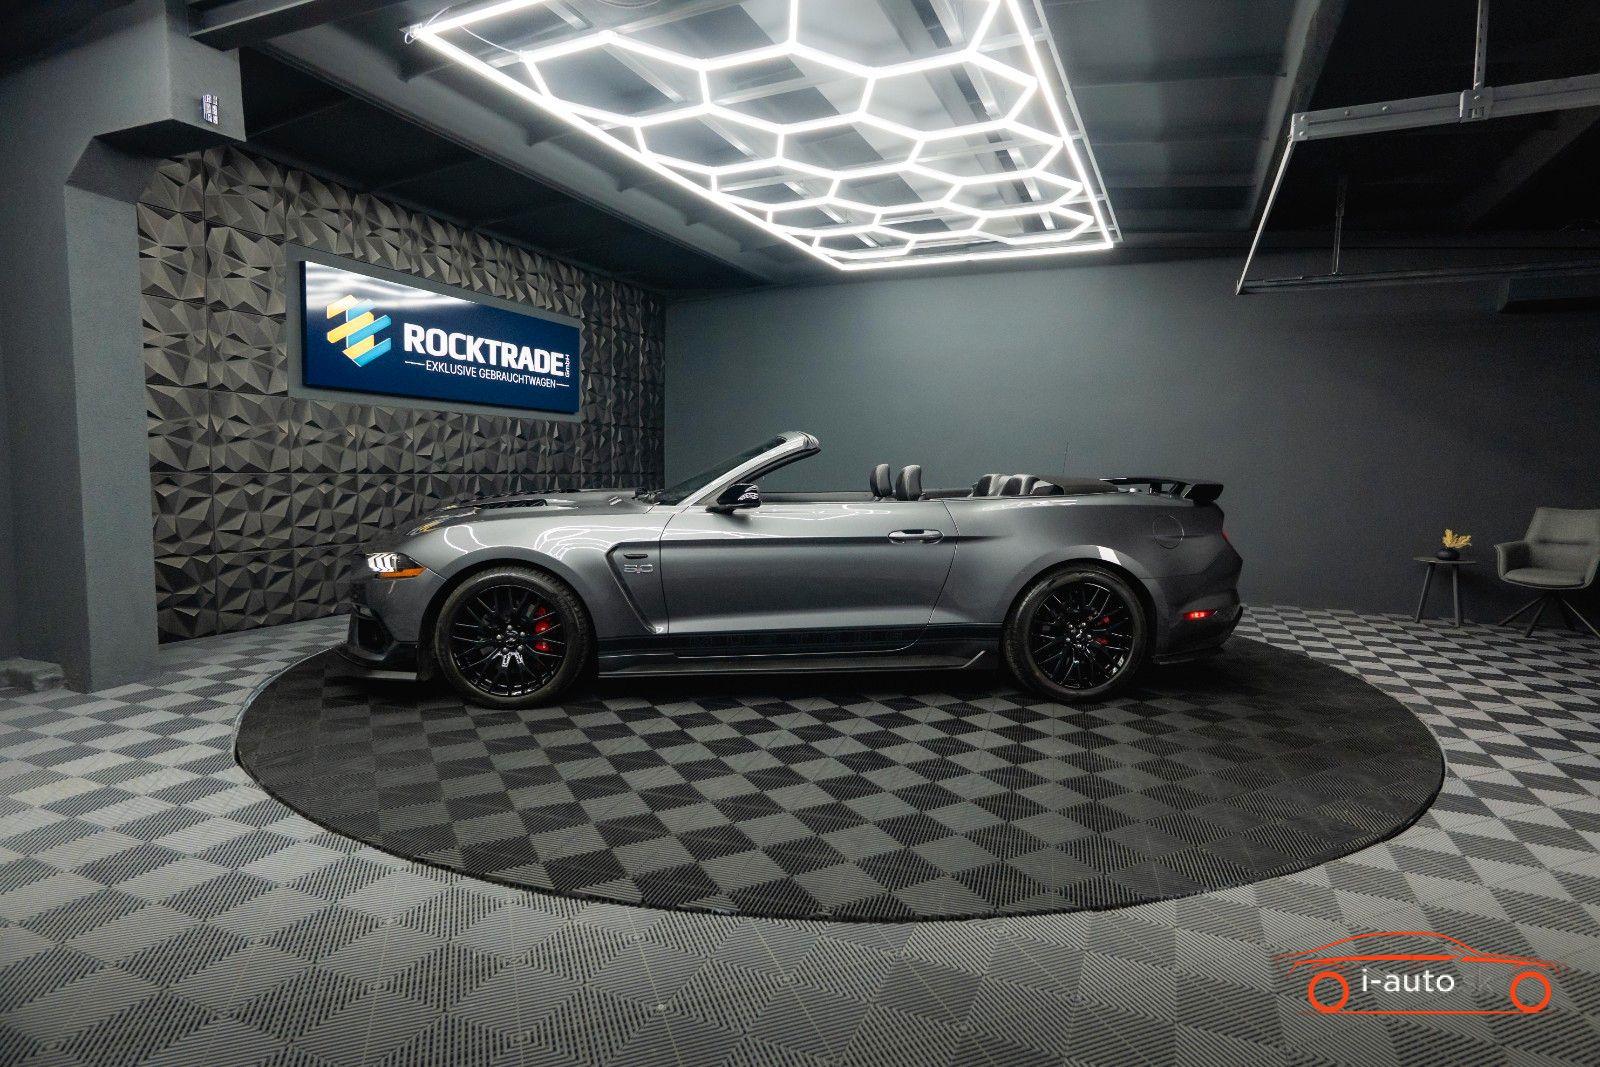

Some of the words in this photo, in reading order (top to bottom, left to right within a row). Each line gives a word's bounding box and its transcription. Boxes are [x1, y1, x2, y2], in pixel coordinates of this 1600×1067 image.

[403, 322, 564, 377] ROCKTRADE
[426, 360, 477, 378] EXKLUSIVE
[478, 368, 556, 389] GEBRAUCHTWAGEN
